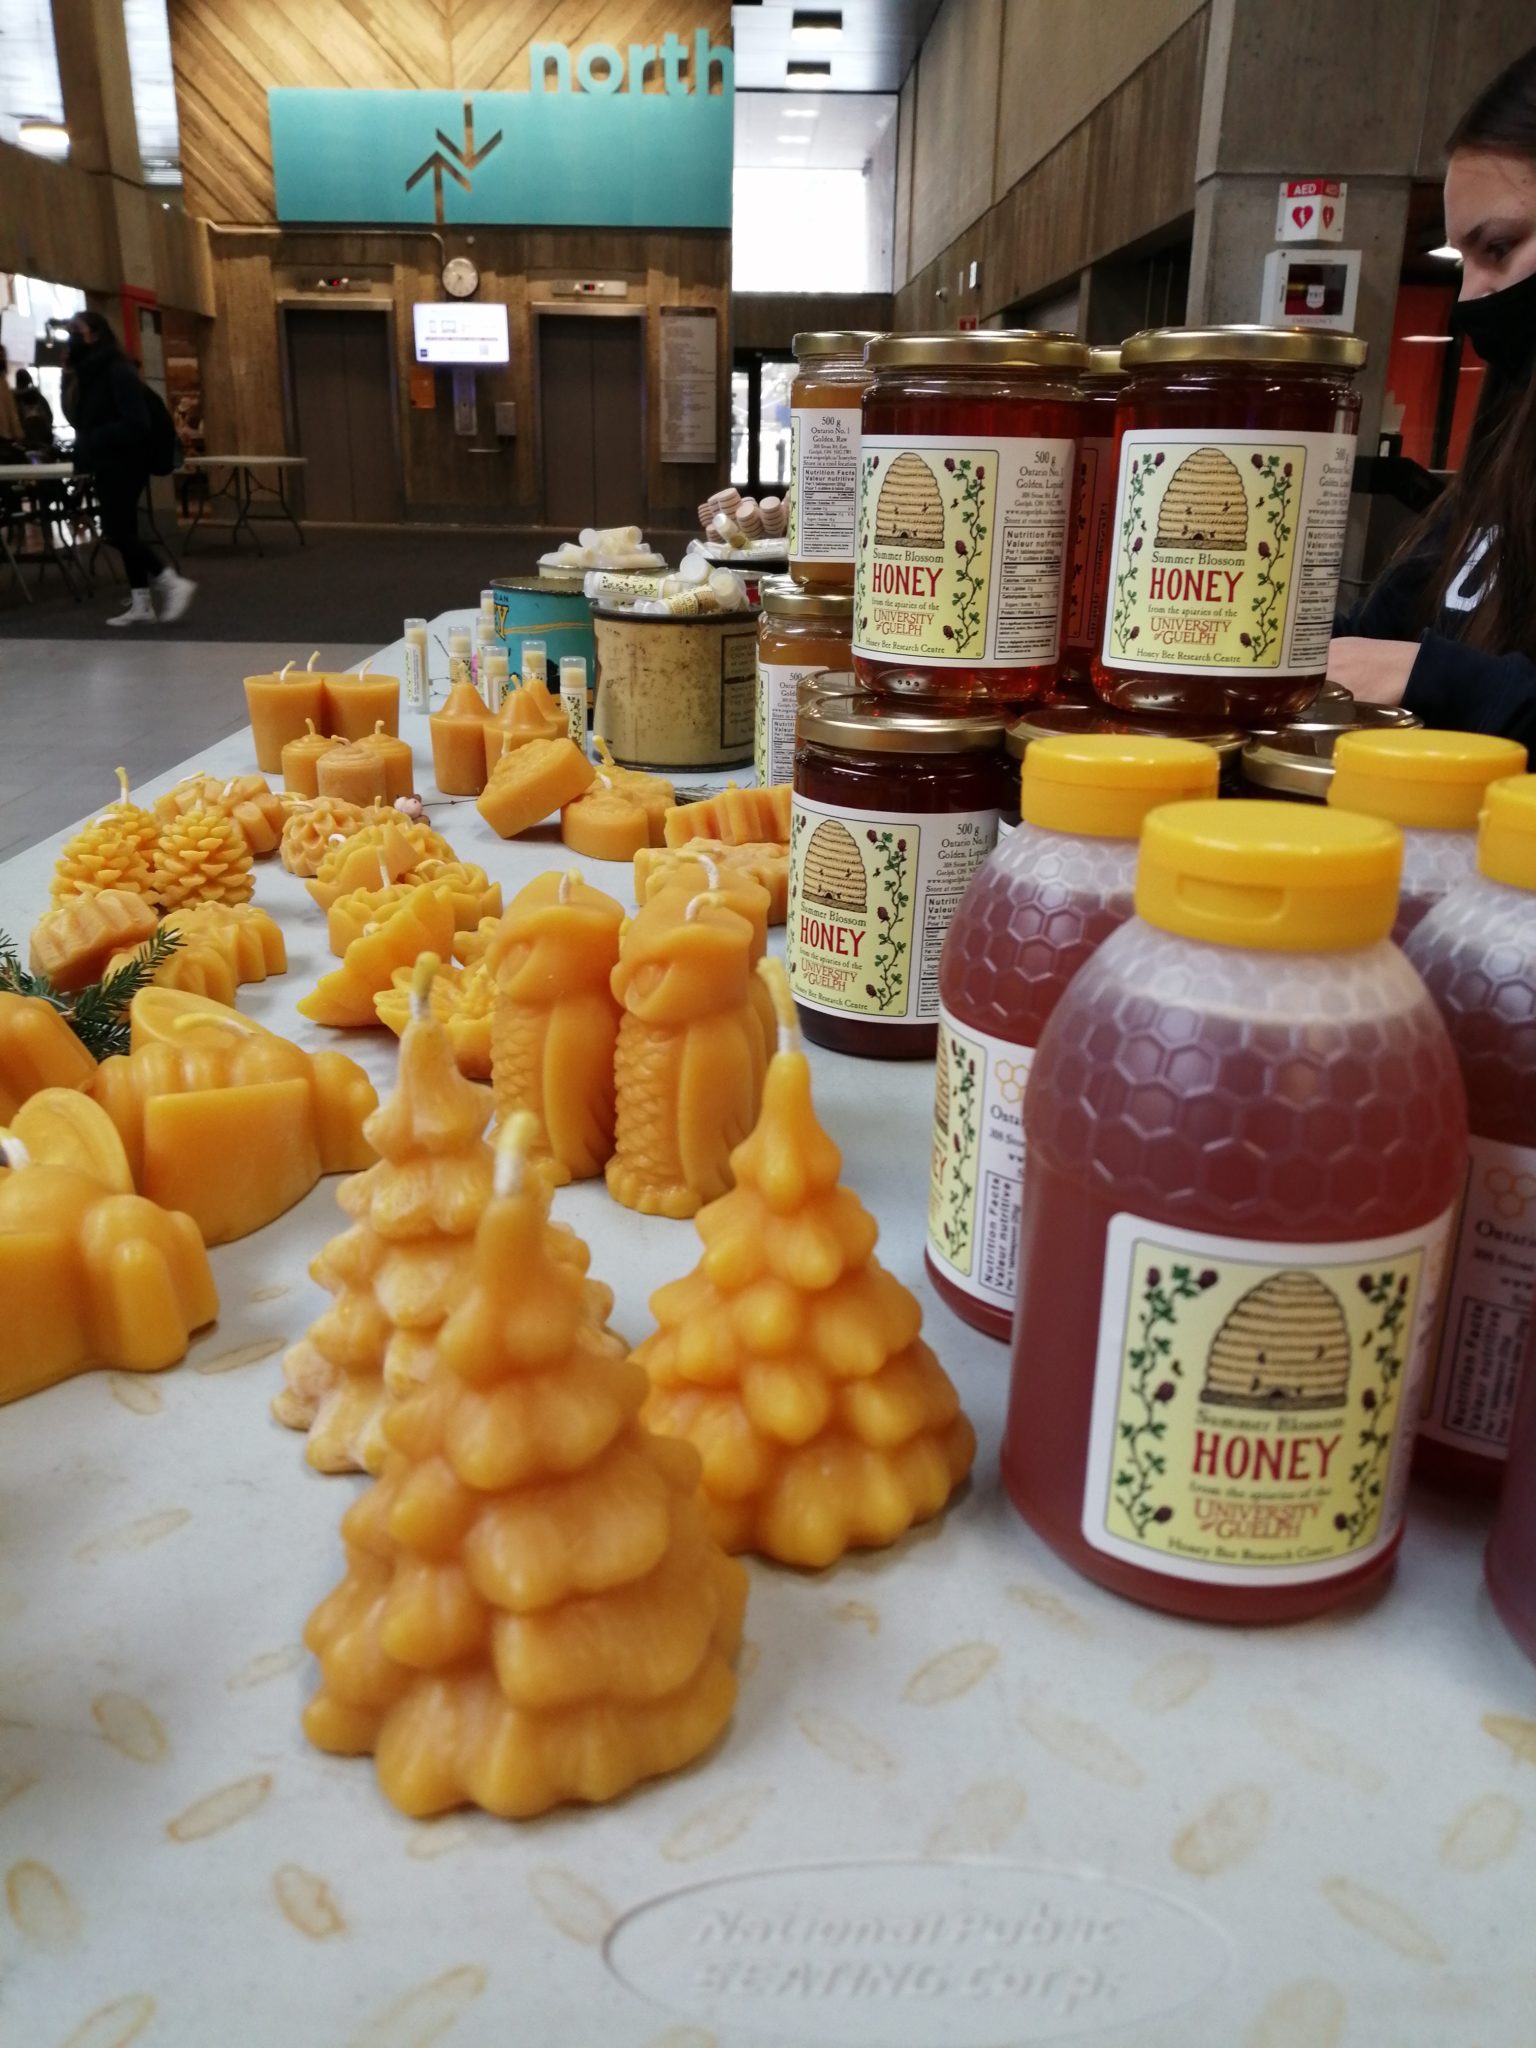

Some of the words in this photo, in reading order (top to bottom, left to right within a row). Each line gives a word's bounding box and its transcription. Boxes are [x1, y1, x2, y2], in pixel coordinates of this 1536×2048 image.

[529, 28, 734, 95] north
[1294, 184, 1316, 195] AED
[822, 417, 834, 425] 500
[1034, 451, 1049, 463] 500
[1020, 466, 1047, 476] Ontario
[874, 548, 902, 560] Summer
[905, 551, 943, 563] Blossom
[1152, 551, 1195, 564] Summer
[1198, 553, 1245, 566] Blossom
[873, 563, 943, 597] HONEY
[1150, 568, 1244, 603] HONEY
[895, 601, 917, 610] apiaries
[1148, 604, 1165, 613] from
[1168, 606, 1179, 614] the
[1182, 607, 1211, 617] apiaries
[1214, 608, 1222, 617] of
[1225, 609, 1237, 617] the
[874, 609, 935, 625] UNIVERSITY
[1151, 617, 1232, 632] UNIVERSITY
[882, 622, 922, 636] GUELPH
[1163, 631, 1216, 645] GUELPH
[866, 638, 880, 647] Honey
[882, 640, 891, 648] Bee
[893, 642, 918, 652] Research
[921, 645, 944, 653] Centre
[1137, 648, 1159, 660] Honey
[1162, 650, 1175, 659] Bee
[1177, 652, 1210, 661] Research
[1214, 653, 1241, 662] Centre
[957, 823, 972, 835] 500
[975, 827, 980, 836] g
[942, 839, 970, 848] Ontario
[938, 850, 966, 859] Golden,
[801, 901, 827, 919] Summer
[830, 910, 866, 927] Blossom
[800, 915, 866, 957] HONEY
[800, 947, 810, 957] from
[820, 955, 841, 967] apiaries
[852, 962, 862, 970] the
[801, 957, 857, 982] UNIVERSITY
[808, 972, 846, 992] GUELPH
[808, 989, 816, 998] Bee
[818, 992, 843, 1005] Research
[845, 998, 868, 1010] Centre
[990, 1104, 1023, 1127] Onta
[989, 1178, 999, 1217] Facts
[995, 1245, 1006, 1287] Valeur
[1001, 1183, 1011, 1241] nutritive
[985, 1222, 997, 1283] Nutrition
[1196, 1409, 1270, 1432] Summer
[1277, 1416, 1344, 1432] Blossom
[1192, 1430, 1342, 1481] HONEY
[1195, 1499, 1321, 1519] UNIVERSITY
[1216, 1518, 1301, 1539] GUELPH
[1168, 1537, 1209, 1557] Honey
[695, 1908, 945, 1946] National
